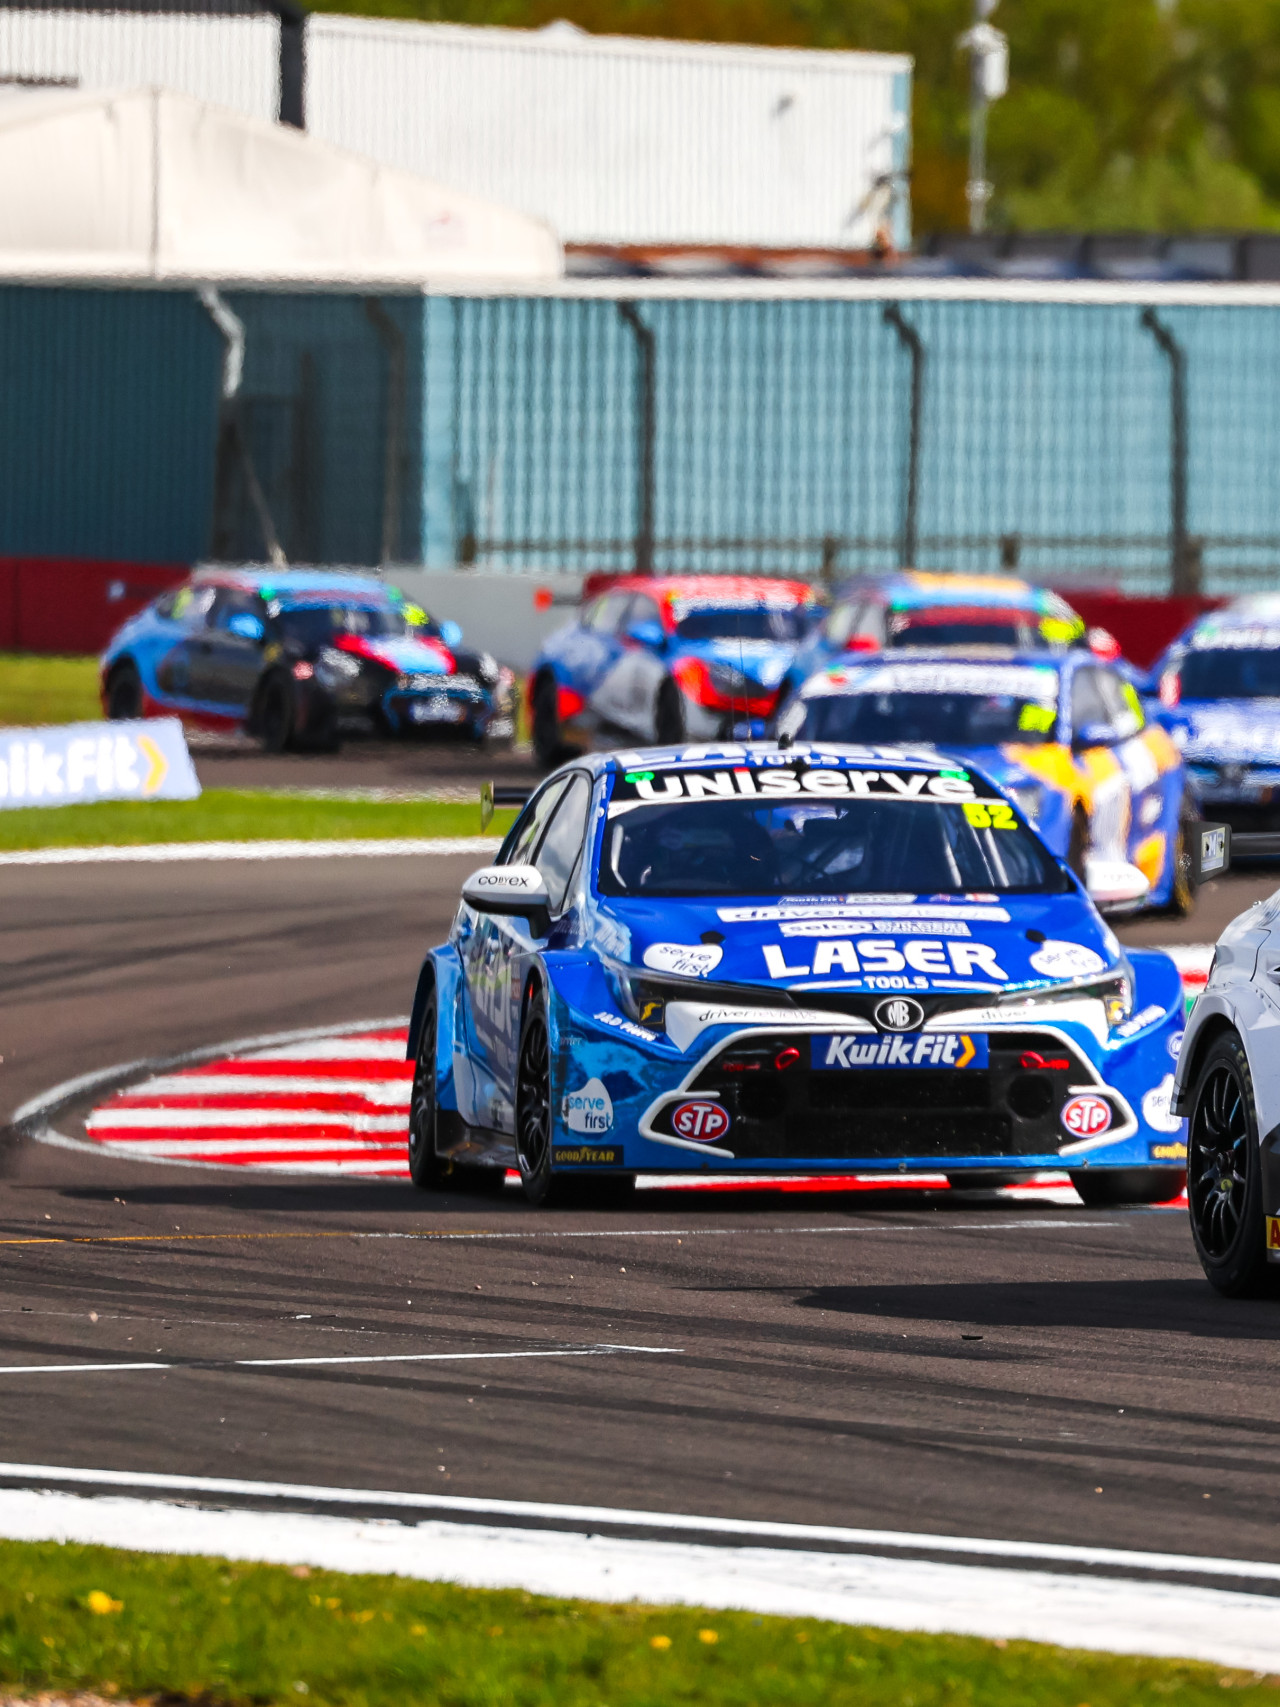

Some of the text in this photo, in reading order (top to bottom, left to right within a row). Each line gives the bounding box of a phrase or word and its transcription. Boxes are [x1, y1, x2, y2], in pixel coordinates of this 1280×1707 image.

[962, 803, 1018, 829] 52
[659, 945, 713, 961] serve
[762, 940, 1009, 980] LASER
[864, 975, 930, 989] TOOLS
[568, 1096, 605, 1111] serve
[1069, 1101, 1107, 1132] STP
[678, 1105, 724, 1136] STP
